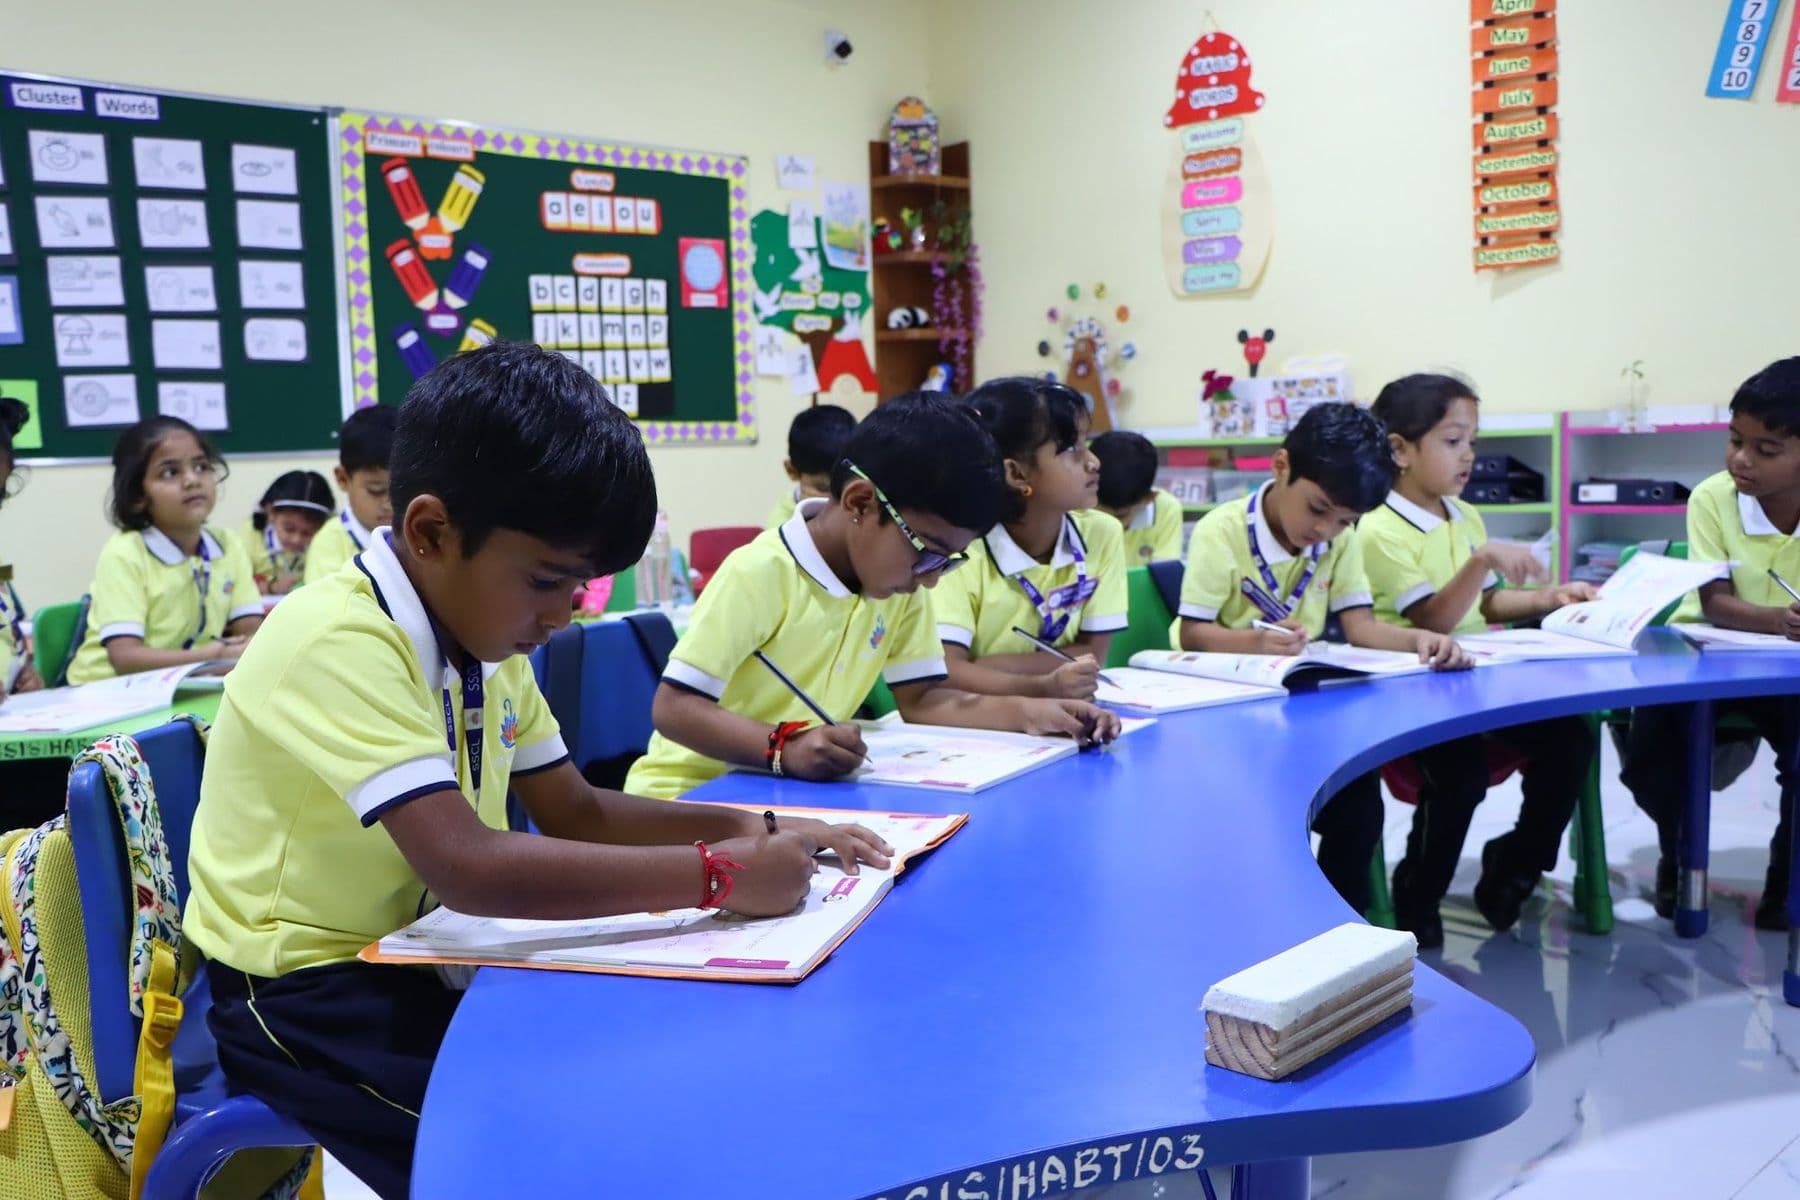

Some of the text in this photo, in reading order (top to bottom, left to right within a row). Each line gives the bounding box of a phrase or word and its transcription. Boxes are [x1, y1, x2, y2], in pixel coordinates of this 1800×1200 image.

[1493, 0, 1533, 12] April
[1749, 3, 1762, 19] 7
[1493, 29, 1527, 42] May
[1742, 24, 1756, 41] 8
[1737, 46, 1750, 63] 9
[1492, 58, 1530, 74] June
[1723, 71, 1748, 88] 10
[17, 87, 156, 115] Cluster Words
[1502, 90, 1532, 105] July
[1487, 120, 1544, 139] August
[1483, 183, 1549, 202] October
[1480, 213, 1557, 231] November
[1477, 245, 1558, 263] December
[472, 738, 481, 772] SSCL
